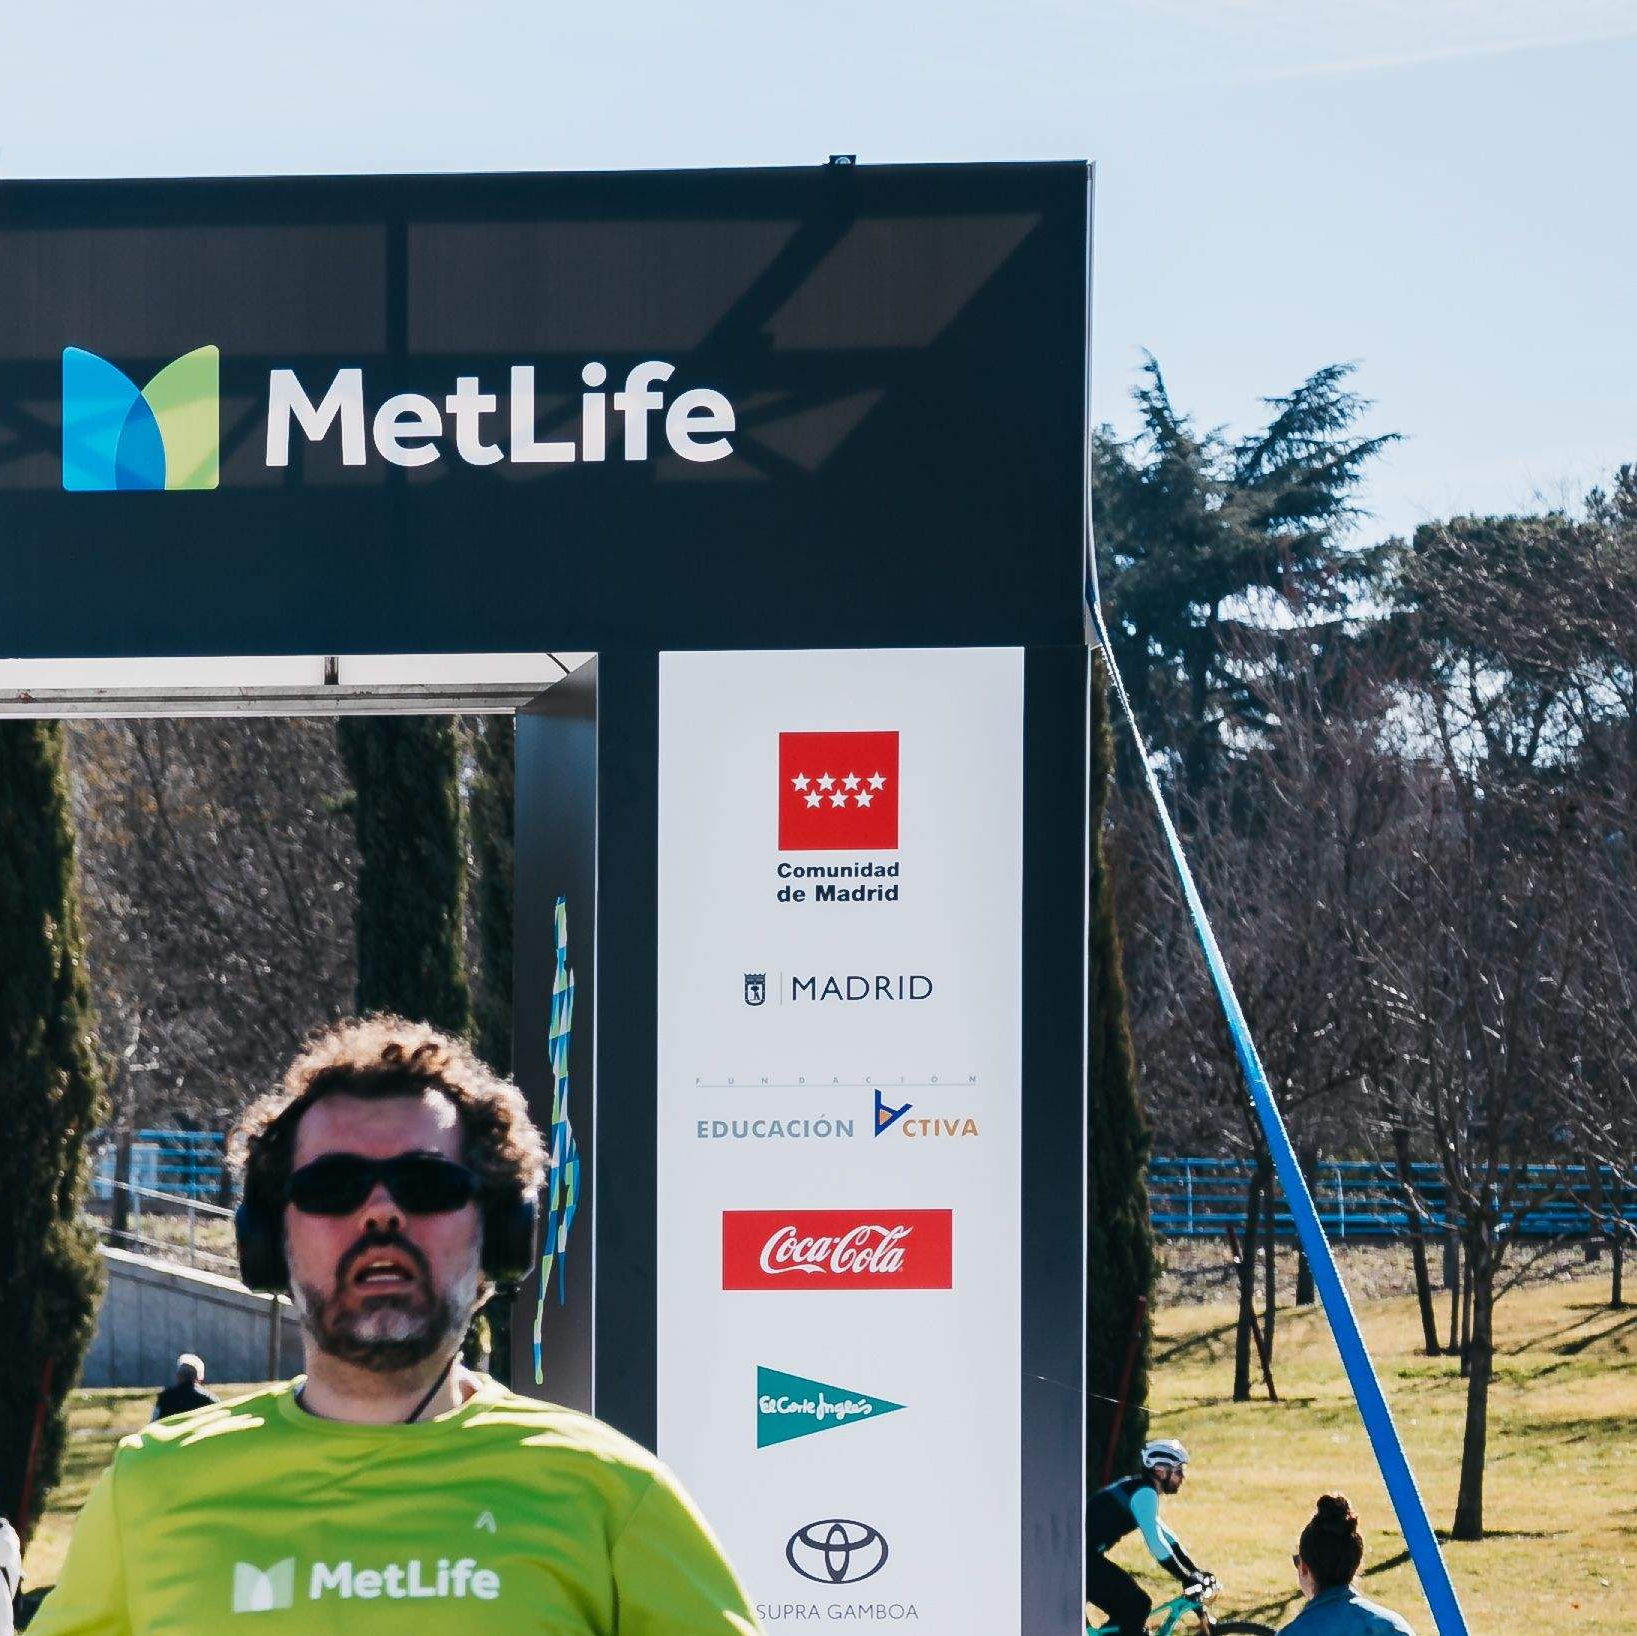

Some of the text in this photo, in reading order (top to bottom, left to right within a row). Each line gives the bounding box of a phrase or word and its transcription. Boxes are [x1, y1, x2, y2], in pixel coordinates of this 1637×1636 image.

[265, 360, 737, 467] MetLife
[776, 861, 900, 879] Comunidad
[776, 884, 900, 903] de Madrid
[791, 975, 934, 1001] MADRID
[696, 1113, 855, 1139] EDUCACIÓN
[308, 1557, 501, 1600] MetLife
[755, 1603, 919, 1621] SUPRA GAMBOA
